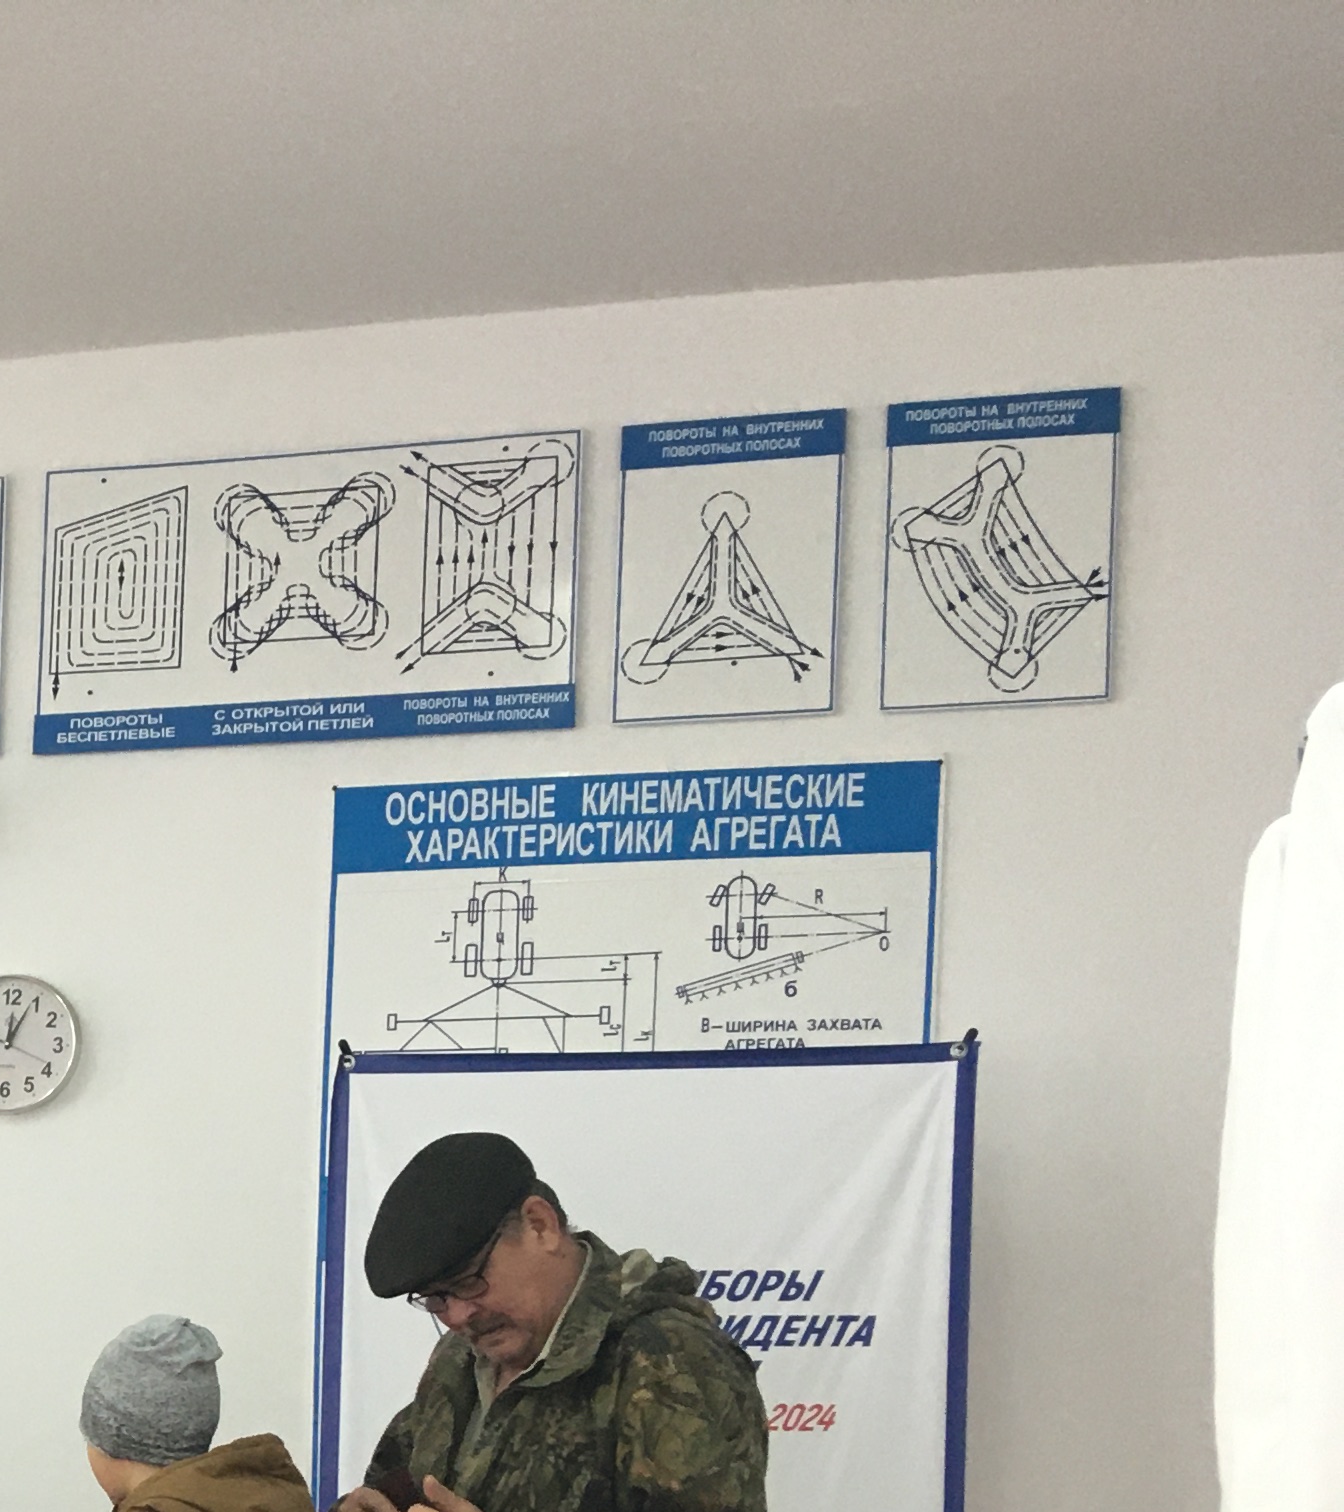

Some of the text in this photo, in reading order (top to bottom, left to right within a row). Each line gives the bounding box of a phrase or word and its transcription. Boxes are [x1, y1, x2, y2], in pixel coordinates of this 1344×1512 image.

[906, 398, 1087, 422] ПОВОРОТЫ НА ВНУТРЕННИХ
[649, 419, 824, 442] ПОВОРОТЫ НА ВНУТРЕННИХ
[930, 414, 1075, 435] ПОВОРОТНЫХ ПОЛОСАХ
[662, 437, 801, 458] ПОВОРОТНЫХ ПОЛОСАХ
[404, 691, 570, 710] ПОВОРОТЫ НА ВНУТРЕННИХ
[231, 702, 323, 719] ОТКРЫТОЙ
[331, 702, 365, 714] ИЛИ
[417, 707, 550, 725] ПОВОРОТНЫХ ПОЛОСАХ
[70, 713, 164, 728] ПОВОРОТЫ
[212, 713, 374, 734] ЗАКРЫТОЙ ПЕТЛЕЙ
[56, 726, 176, 744] БЕСПЕТЛЕВЫЕ
[385, 773, 867, 827] ОСНОВНЫЕ КИНЕМАТИЧЕСКИЕ
[405, 814, 842, 864] ХАРАКТЕРИСТИКИ АГРЕГАТА
[3, 988, 22, 1005] 12
[32, 996, 40, 1013] 1
[46, 1011, 57, 1028] 2
[806, 1018, 883, 1032] ЗАХВАТА
[52, 1036, 63, 1053] 3
[725, 1038, 807, 1050] АГРЕГАТА
[41, 1061, 52, 1078] 4
[0, 1081, 10, 1098] 6
[23, 1076, 35, 1092] 5
[696, 1270, 825, 1302] БОРЫ
[717, 1314, 877, 1351] ИДЕНТА
[767, 1403, 837, 1432] 2024
